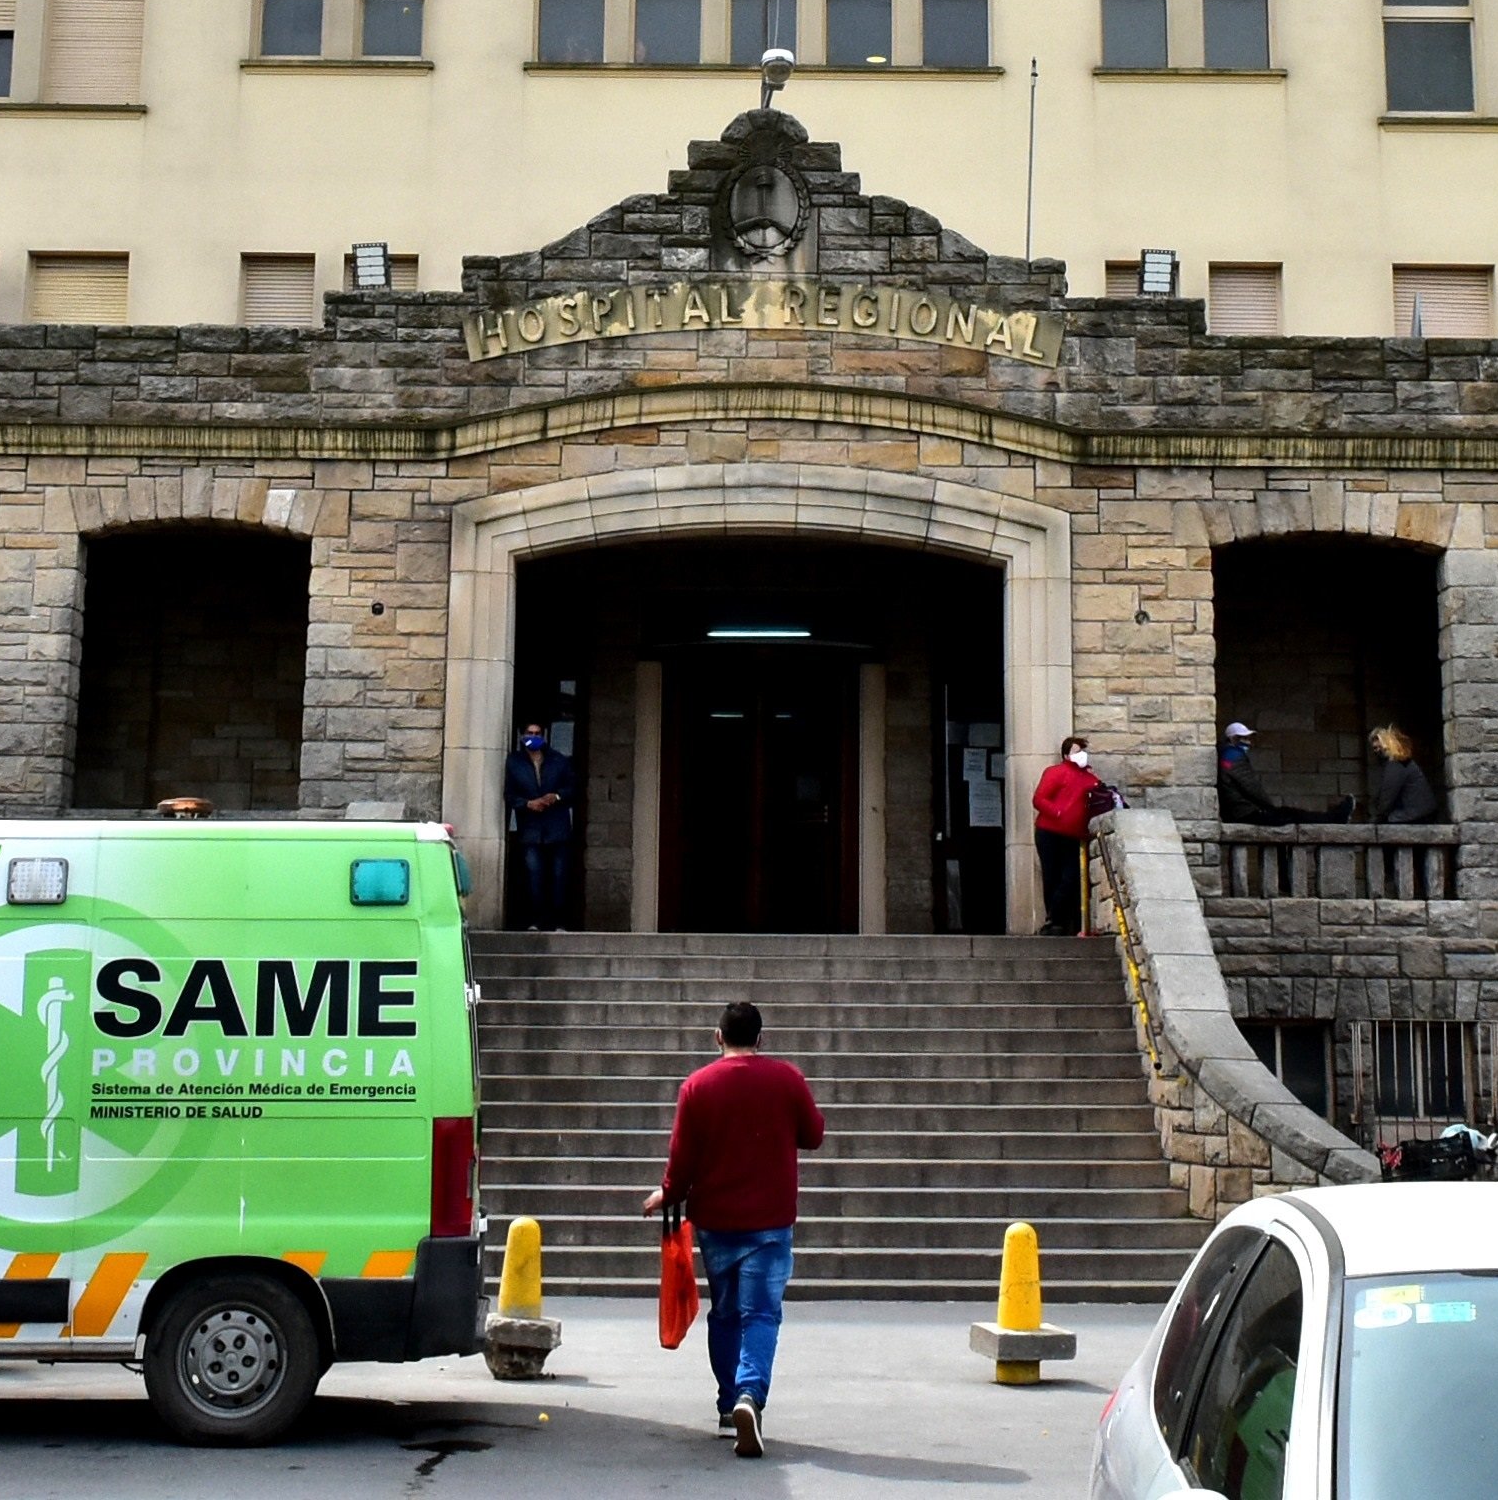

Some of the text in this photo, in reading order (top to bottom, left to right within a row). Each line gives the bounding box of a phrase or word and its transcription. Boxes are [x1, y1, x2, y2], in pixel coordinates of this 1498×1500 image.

[479, 285, 1044, 360] HOSPITAL REGIONAL
[92, 957, 418, 1038] SAME
[91, 1049, 416, 1077] PROVINCIA
[91, 1082, 417, 1099] Sistema de Atención Médica de Emergencia
[90, 1106, 263, 1119] MINISTERIO DE SALUD
